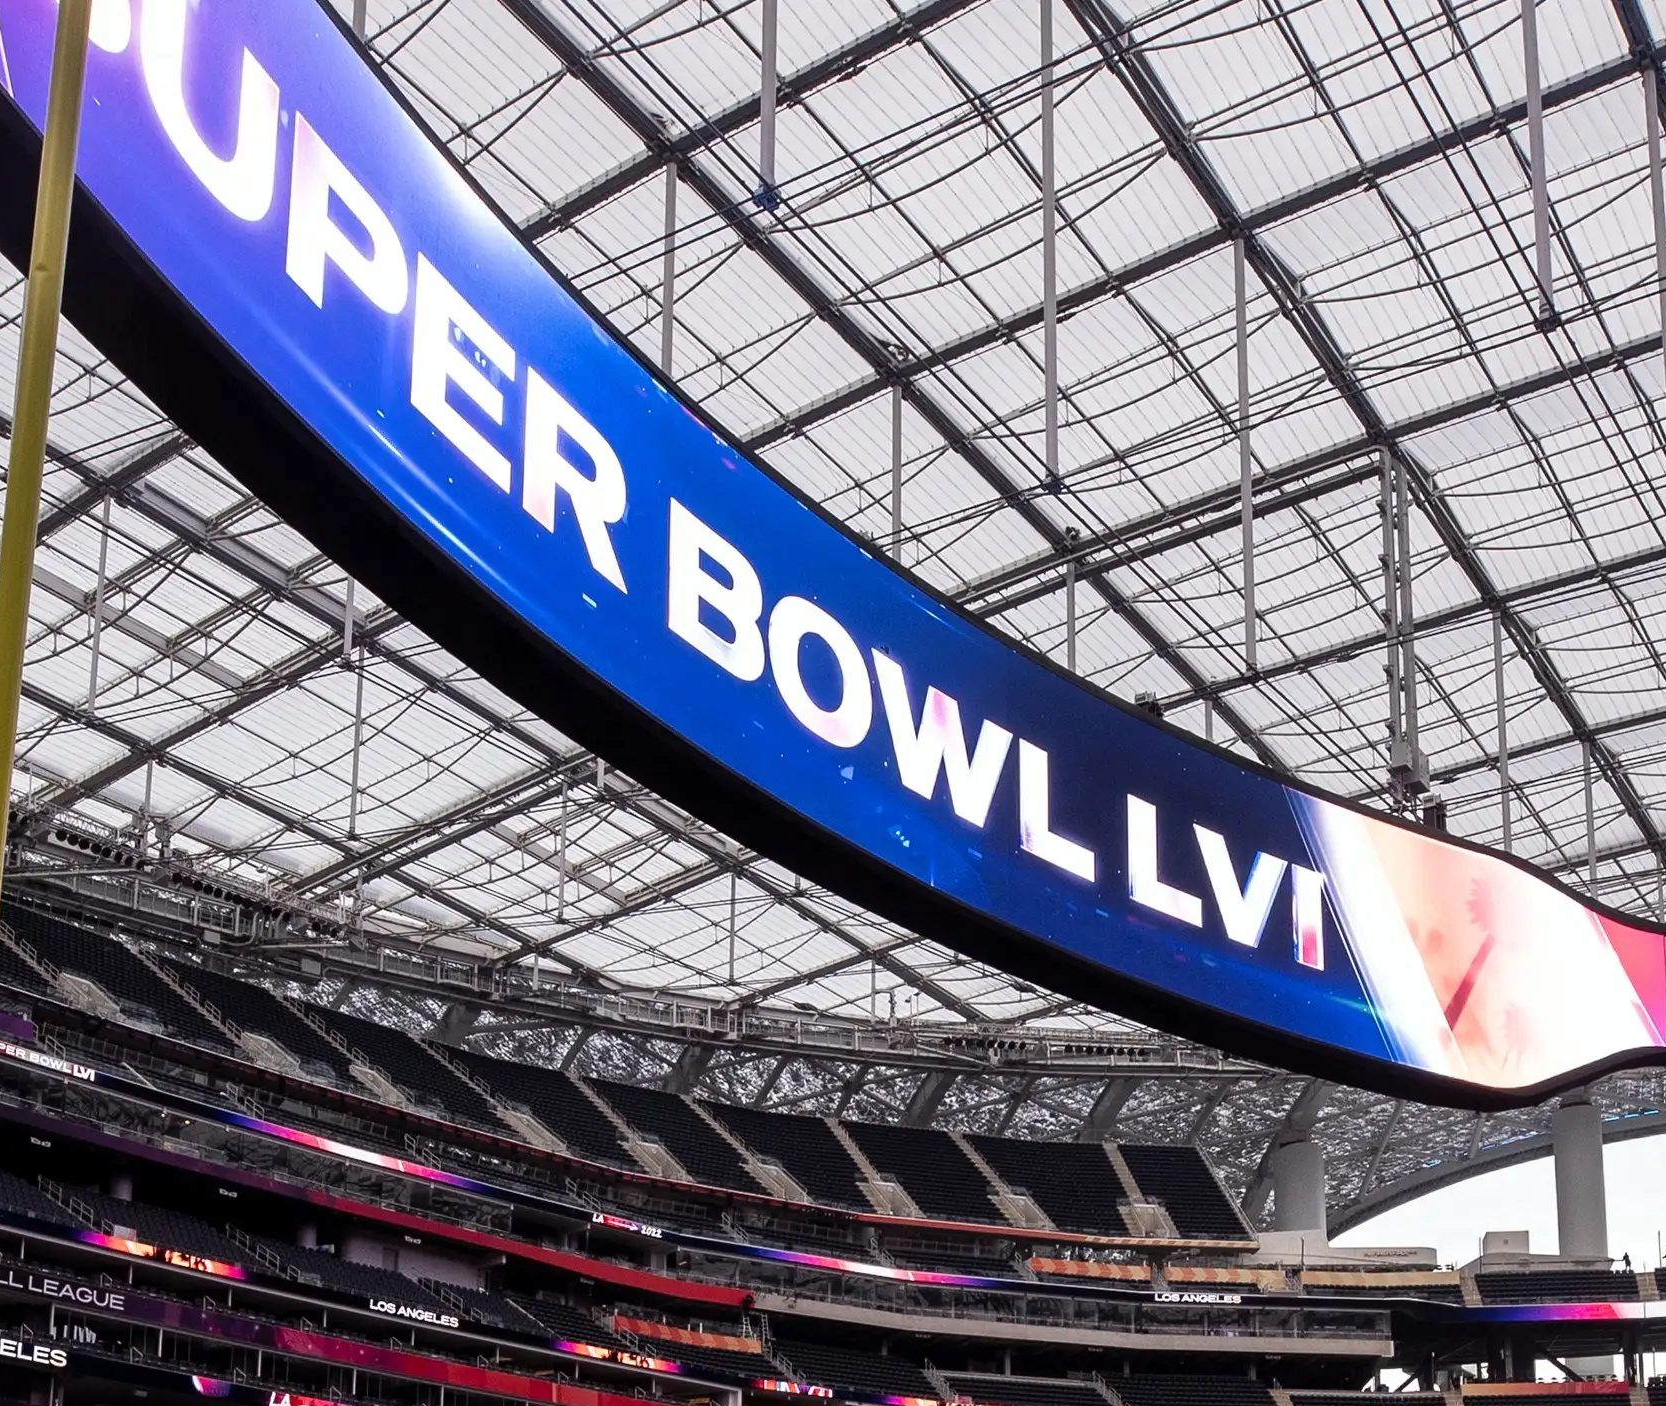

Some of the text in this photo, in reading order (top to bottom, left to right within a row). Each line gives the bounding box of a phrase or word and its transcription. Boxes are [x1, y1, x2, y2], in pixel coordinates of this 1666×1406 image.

[88, 0, 1328, 971] UPER BOWL LVI
[29, 1052, 73, 1075] BOWL
[72, 1063, 96, 1083] LVI
[593, 1212, 662, 1239] LA 2022
[28, 1278, 125, 1311] LEAGUE
[1154, 1292, 1241, 1304] LOS ANGELES
[369, 1298, 459, 1329] LOS ANGELES
